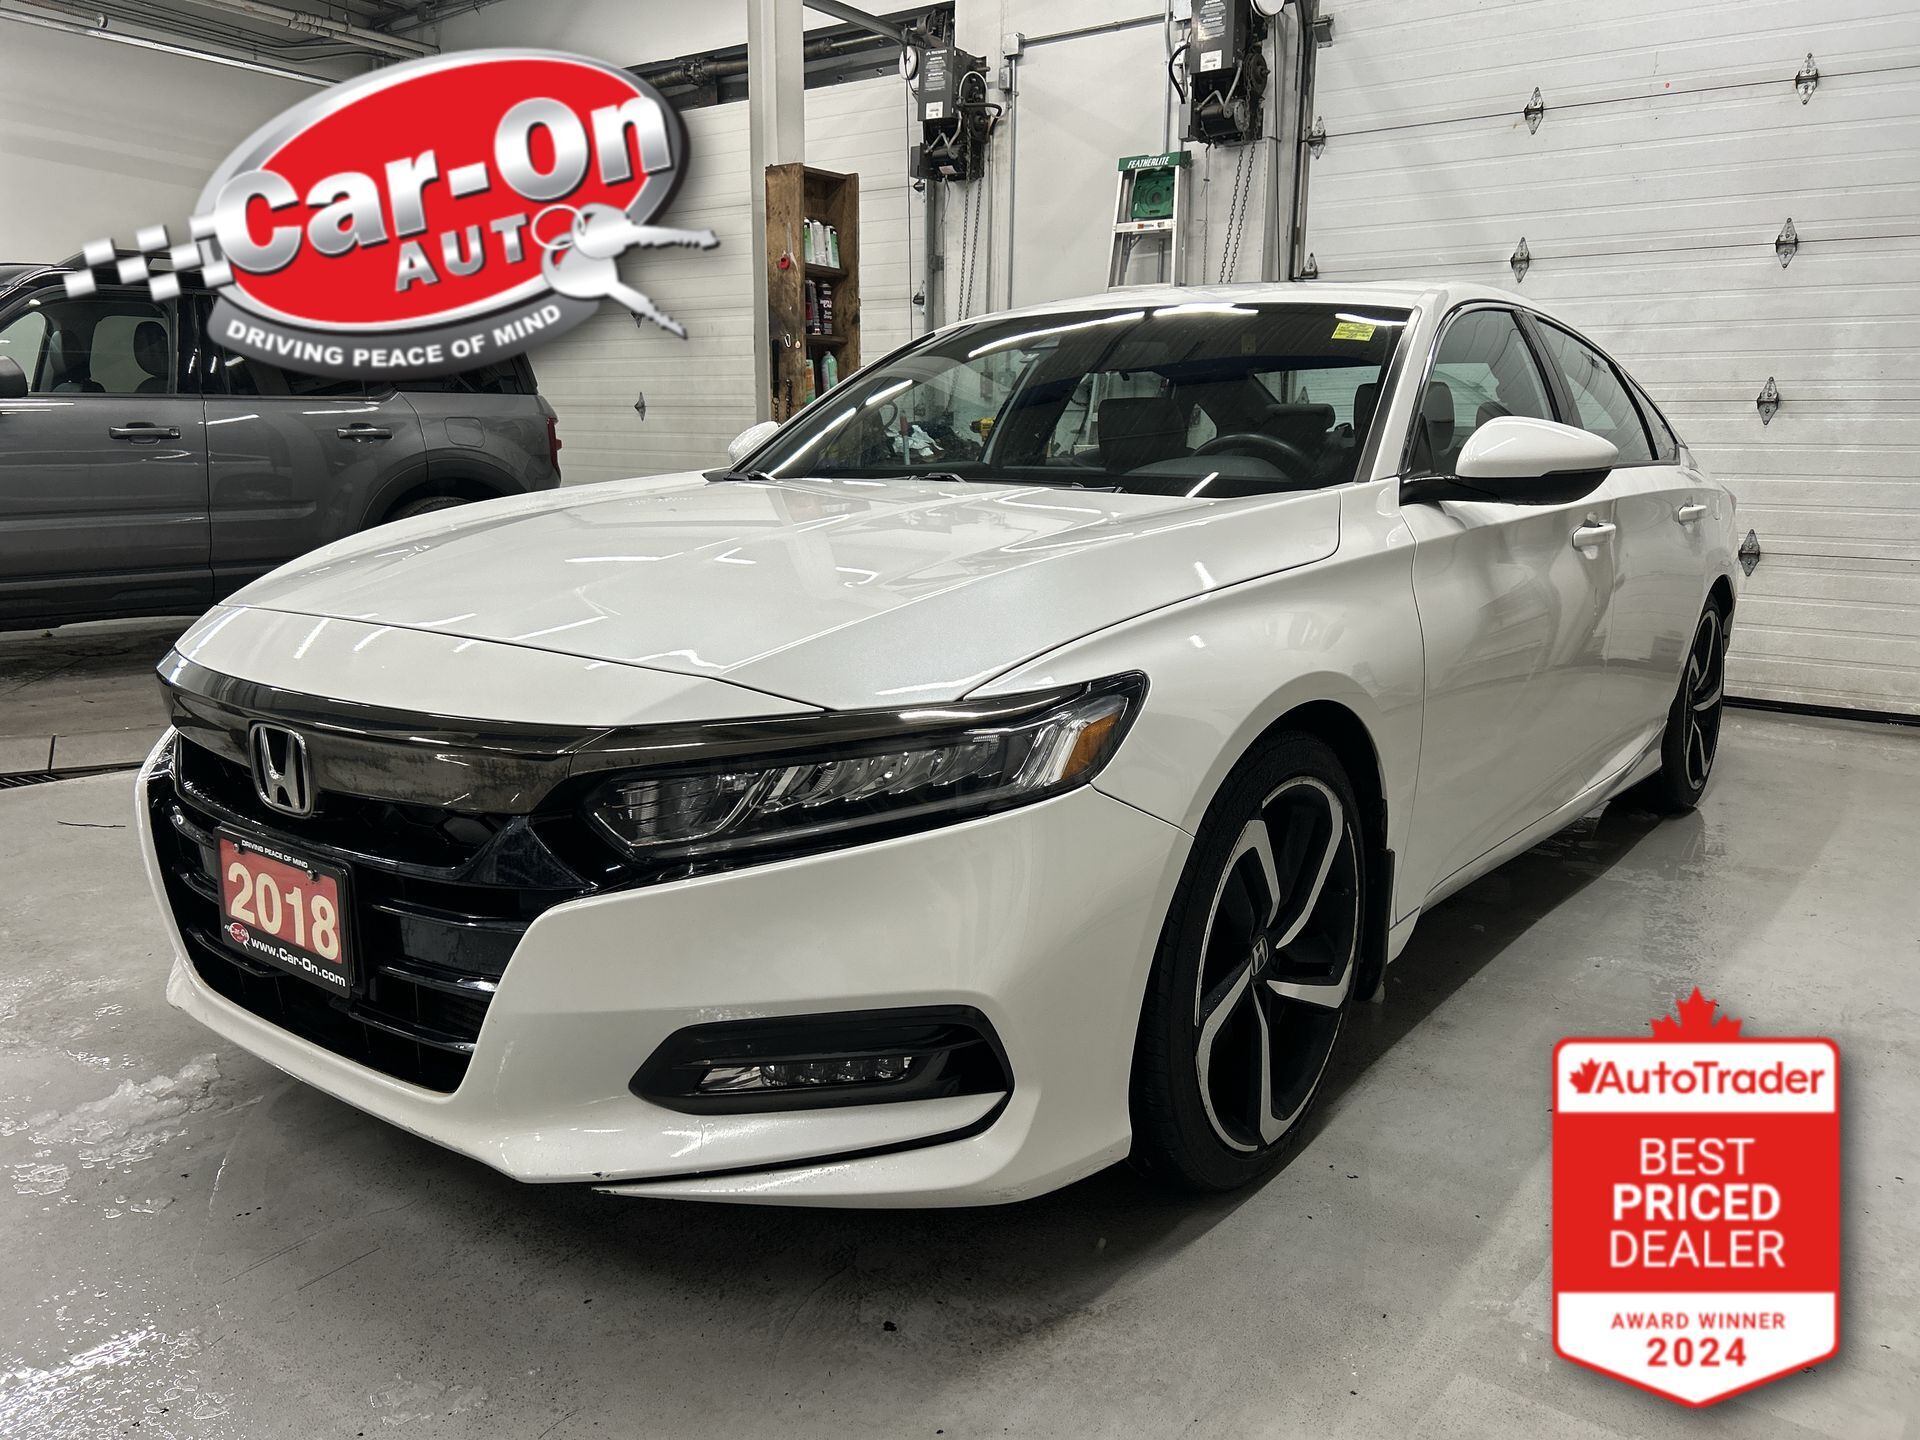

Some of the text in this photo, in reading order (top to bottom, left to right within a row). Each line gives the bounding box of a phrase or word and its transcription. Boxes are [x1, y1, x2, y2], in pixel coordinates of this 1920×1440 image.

[1127, 156, 1170, 169] FEATHERLITE
[241, 839, 309, 869] DRIVING PEACE OF MIND
[228, 862, 339, 960] 2018
[250, 937, 346, 987] www.Car-On.com
